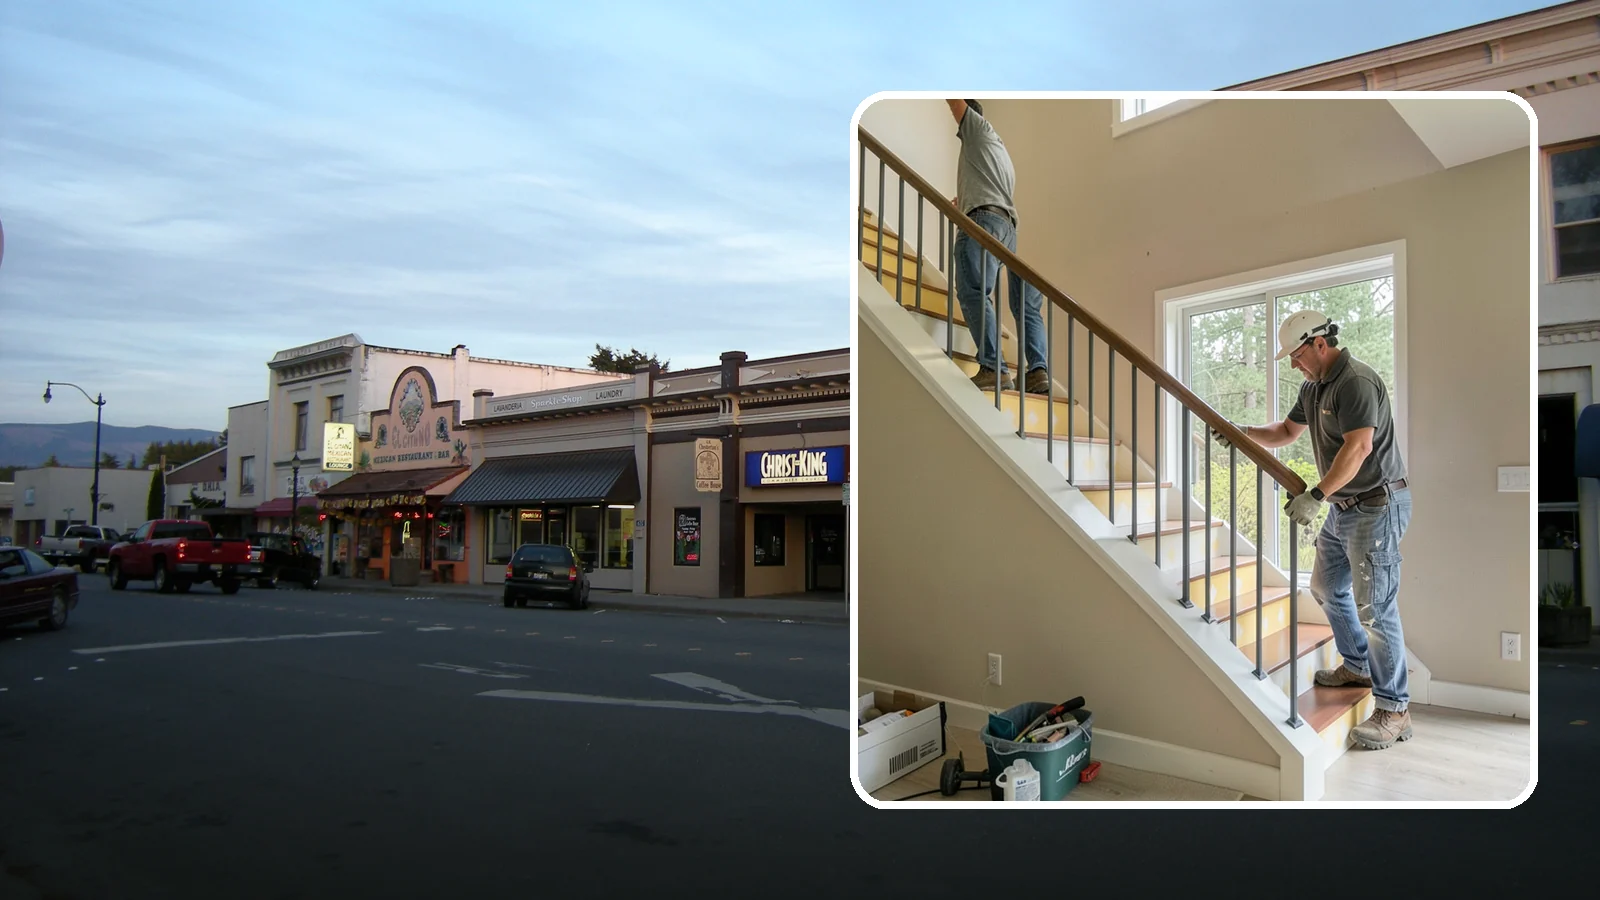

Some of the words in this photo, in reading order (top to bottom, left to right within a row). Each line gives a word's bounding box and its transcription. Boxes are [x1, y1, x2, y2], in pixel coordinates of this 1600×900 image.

[562, 394, 582, 404] Shop
[595, 389, 623, 400] LAUNDRY
[493, 402, 522, 413] LAVANDERIA
[373, 455, 396, 464] MEXICAN
[397, 451, 433, 462] RESTAURANT
[438, 450, 450, 459] BAR
[761, 452, 797, 477] CHRIST
[799, 450, 827, 476] KING
